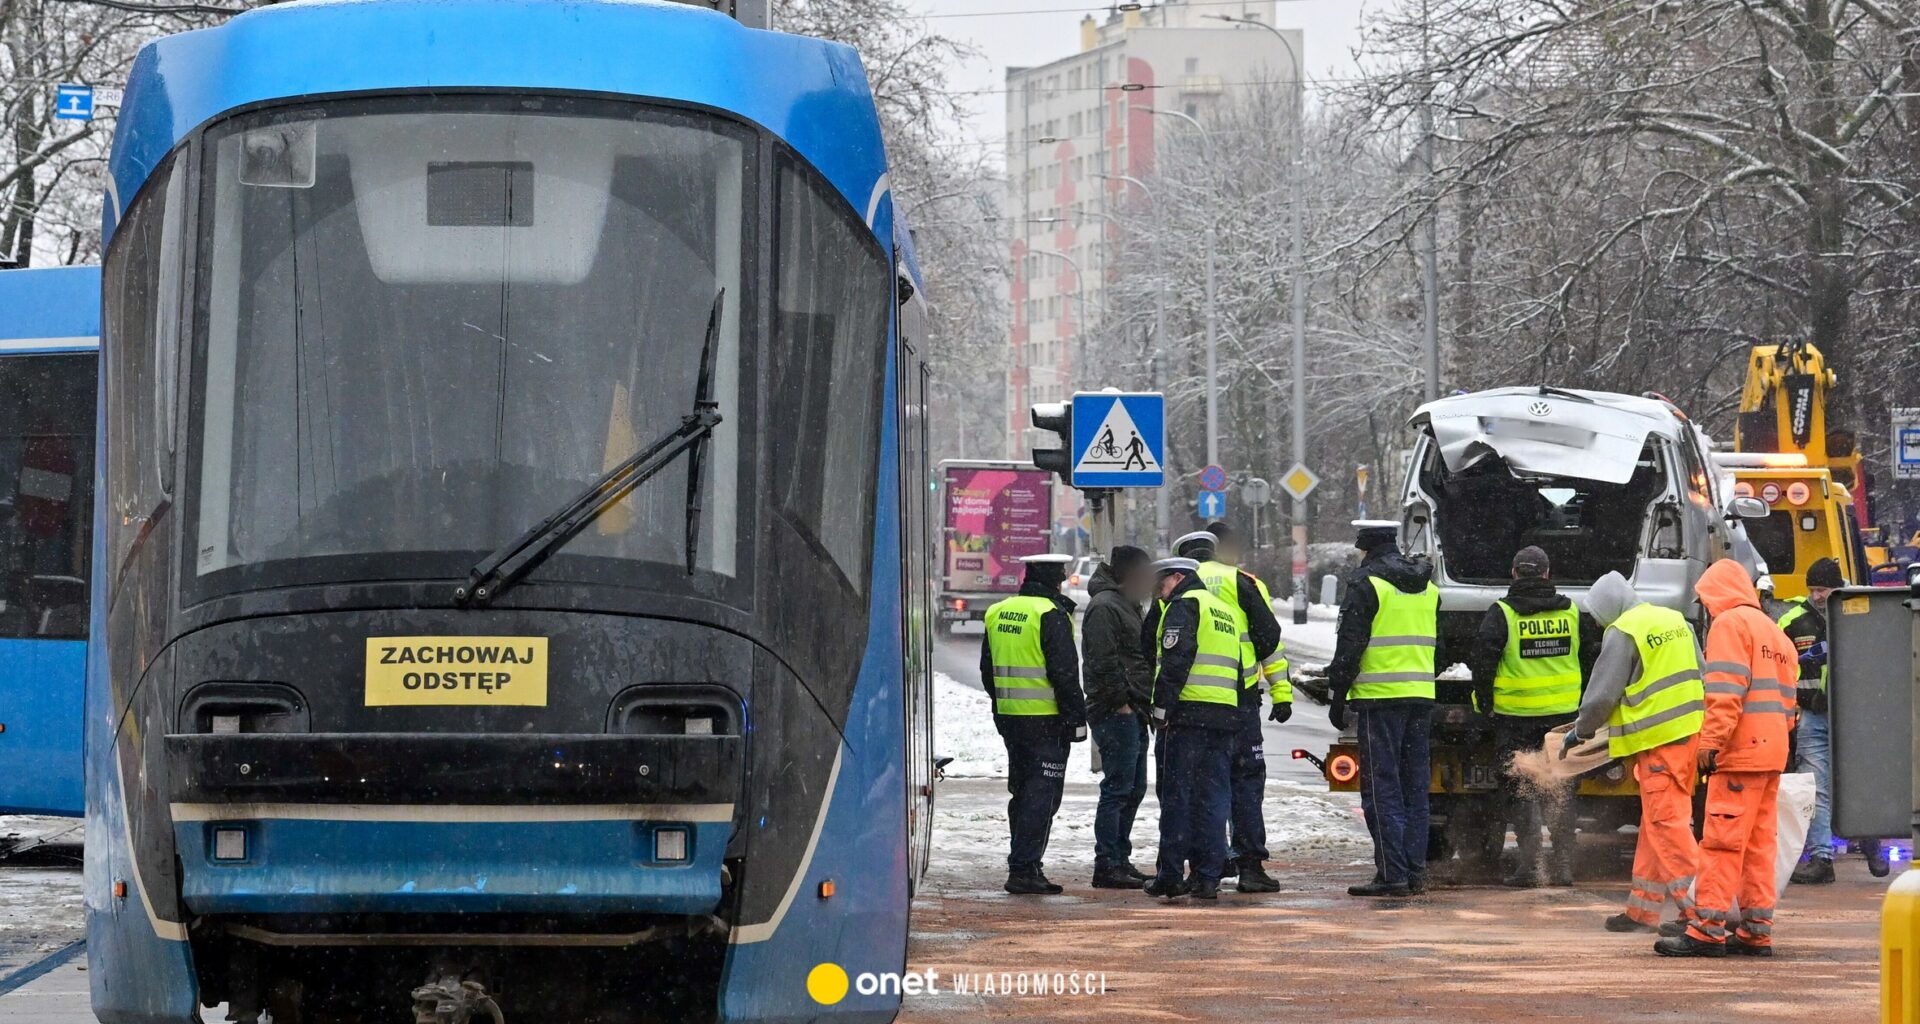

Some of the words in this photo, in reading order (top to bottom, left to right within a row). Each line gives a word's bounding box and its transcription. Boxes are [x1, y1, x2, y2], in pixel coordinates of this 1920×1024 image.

[952, 496, 963, 505] W
[965, 496, 990, 505] domu
[998, 611, 1028, 623] NADZÓR
[997, 623, 1022, 635] RUCHU
[1519, 618, 1570, 636] POLICJA
[1646, 625, 1688, 650] fbserwis
[380, 646, 534, 664] ZACHOWAJ
[403, 672, 511, 694] ODSTĘP
